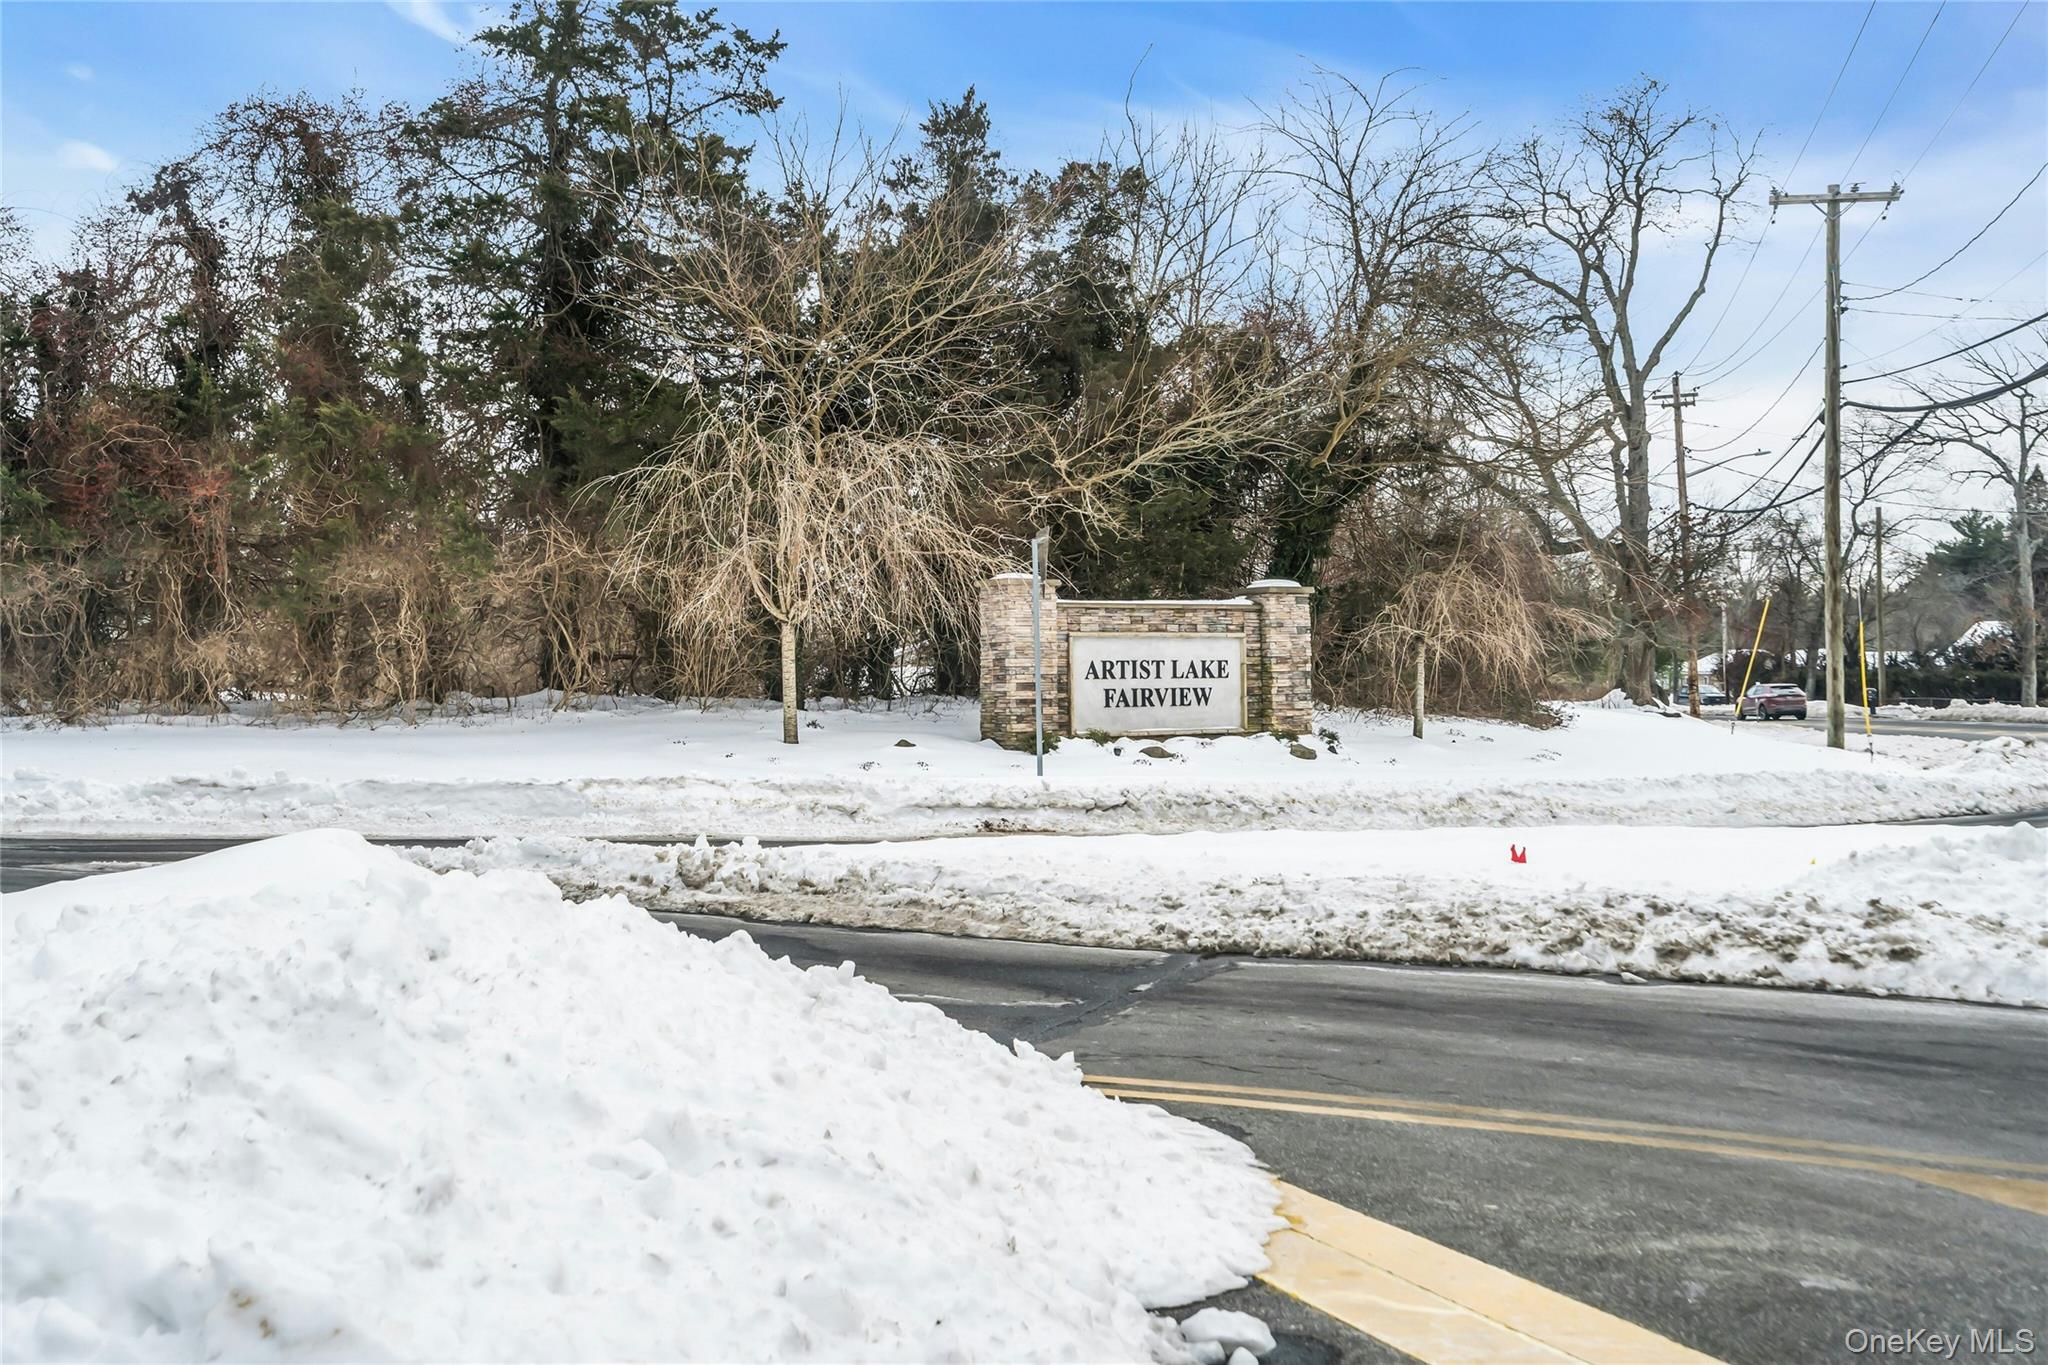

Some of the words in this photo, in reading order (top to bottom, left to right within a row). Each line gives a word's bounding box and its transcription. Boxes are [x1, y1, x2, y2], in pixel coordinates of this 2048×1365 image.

[1084, 659, 1165, 680] ARTIST
[1171, 659, 1230, 679] LAKE
[1103, 687, 1213, 708] FAIRVIEW
